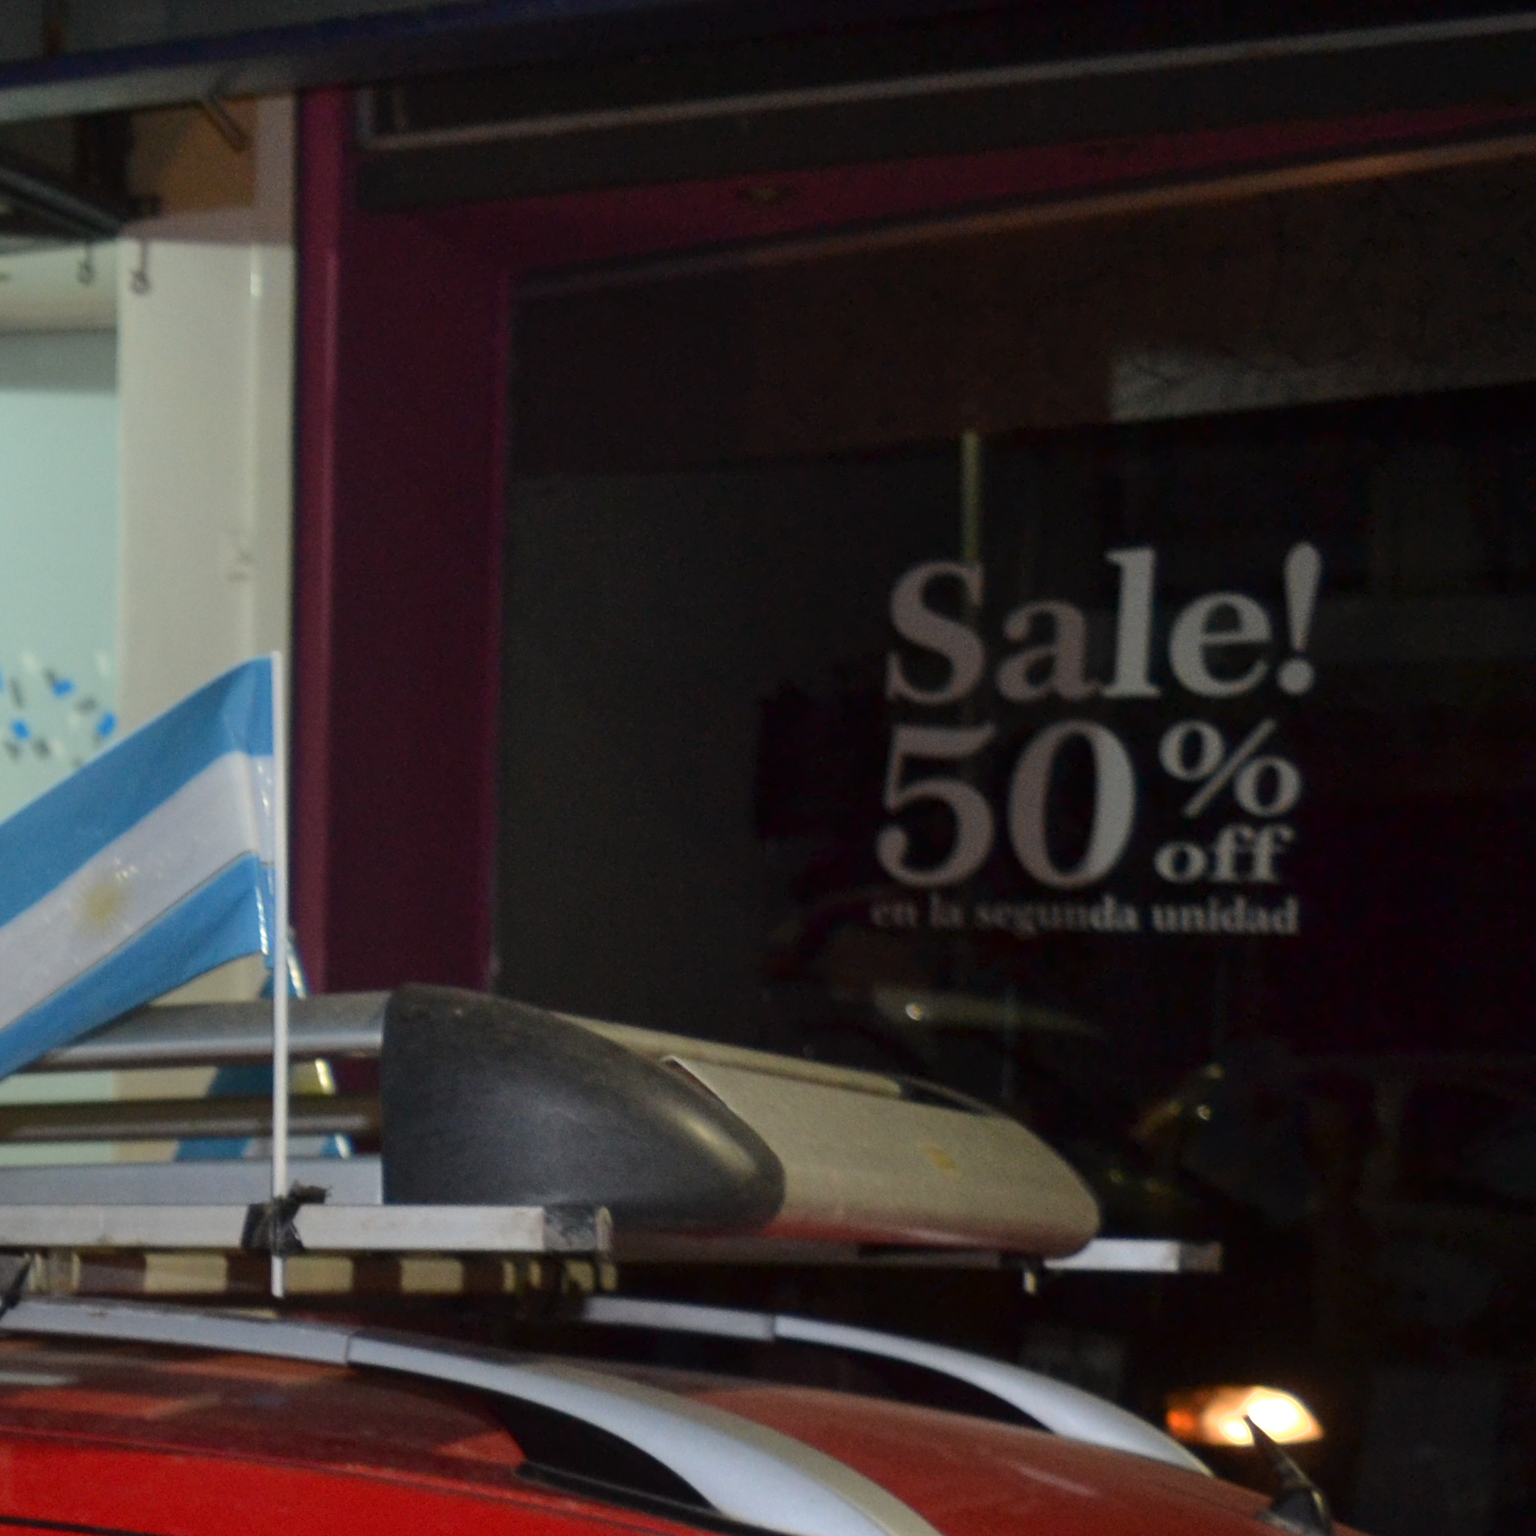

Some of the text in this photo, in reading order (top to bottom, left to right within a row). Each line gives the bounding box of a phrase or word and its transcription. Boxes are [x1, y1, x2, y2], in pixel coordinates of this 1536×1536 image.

[885, 542, 1322, 704] Sale!
[1154, 824, 1294, 884] off
[869, 894, 1301, 938] en la segunda unidad
